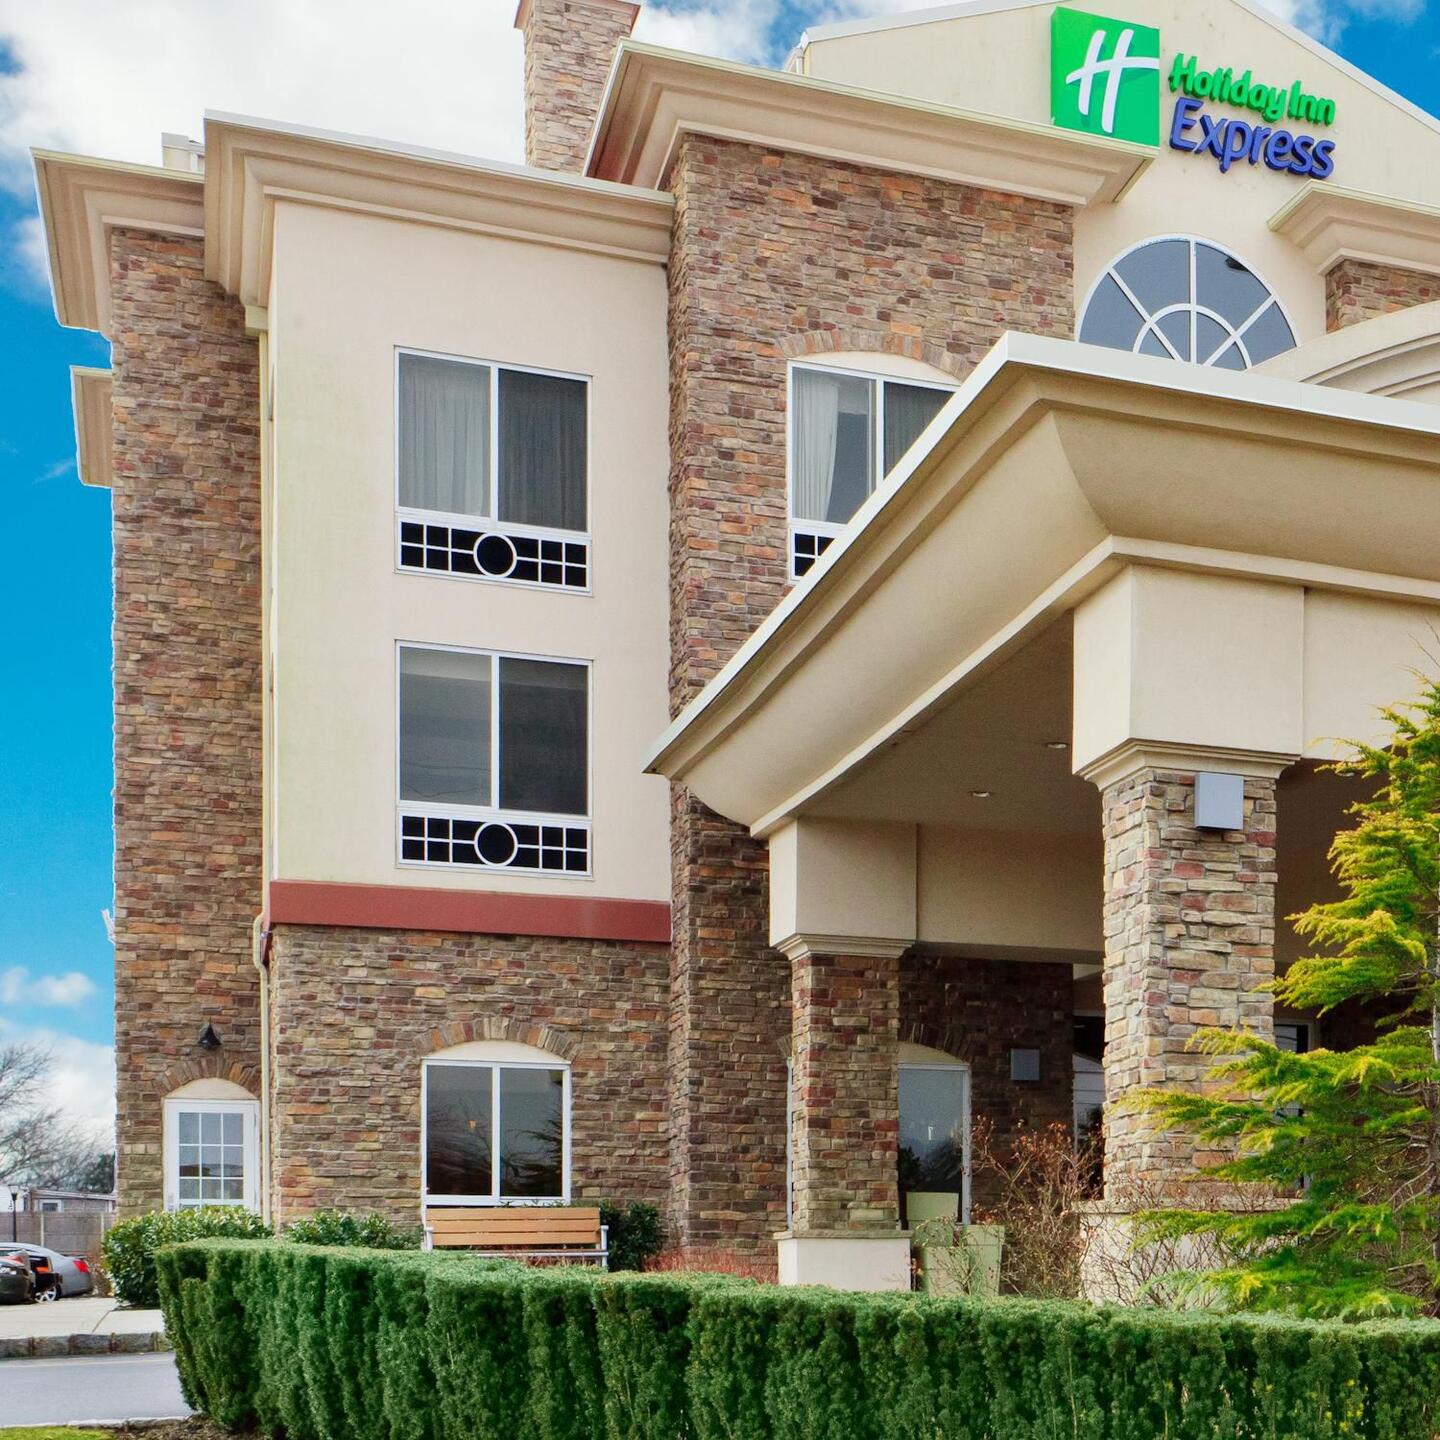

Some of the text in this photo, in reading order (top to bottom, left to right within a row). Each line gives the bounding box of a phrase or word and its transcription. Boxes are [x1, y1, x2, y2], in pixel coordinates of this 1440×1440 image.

[1065, 29, 1160, 133] H
[1168, 53, 1336, 126] Holiday Inn
[1169, 97, 1336, 179] Express
